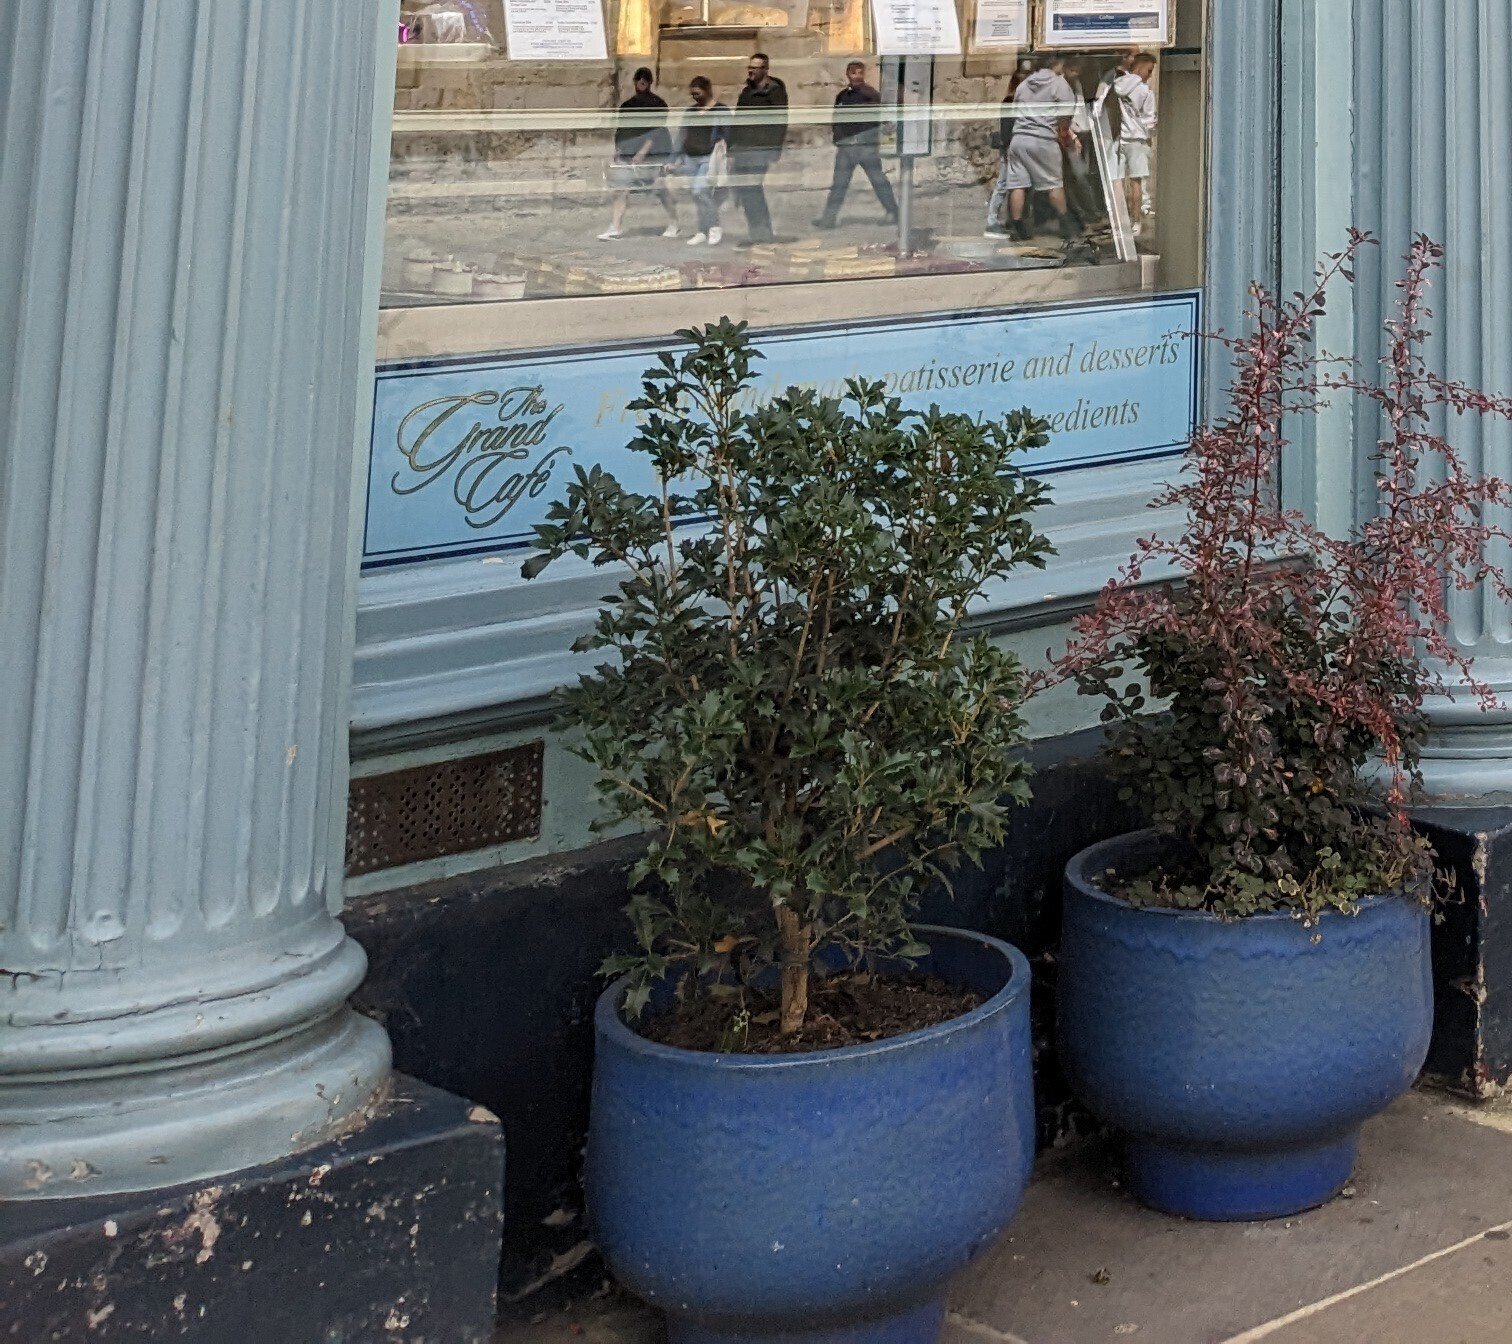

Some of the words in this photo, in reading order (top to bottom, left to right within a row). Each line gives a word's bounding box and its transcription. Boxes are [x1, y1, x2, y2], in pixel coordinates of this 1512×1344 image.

[884, 353, 1015, 395] patisserie
[1022, 343, 1074, 380] and
[1080, 339, 1180, 373] desserts
[498, 384, 548, 421] The
[391, 390, 565, 495] Grand
[454, 446, 572, 529] Café
